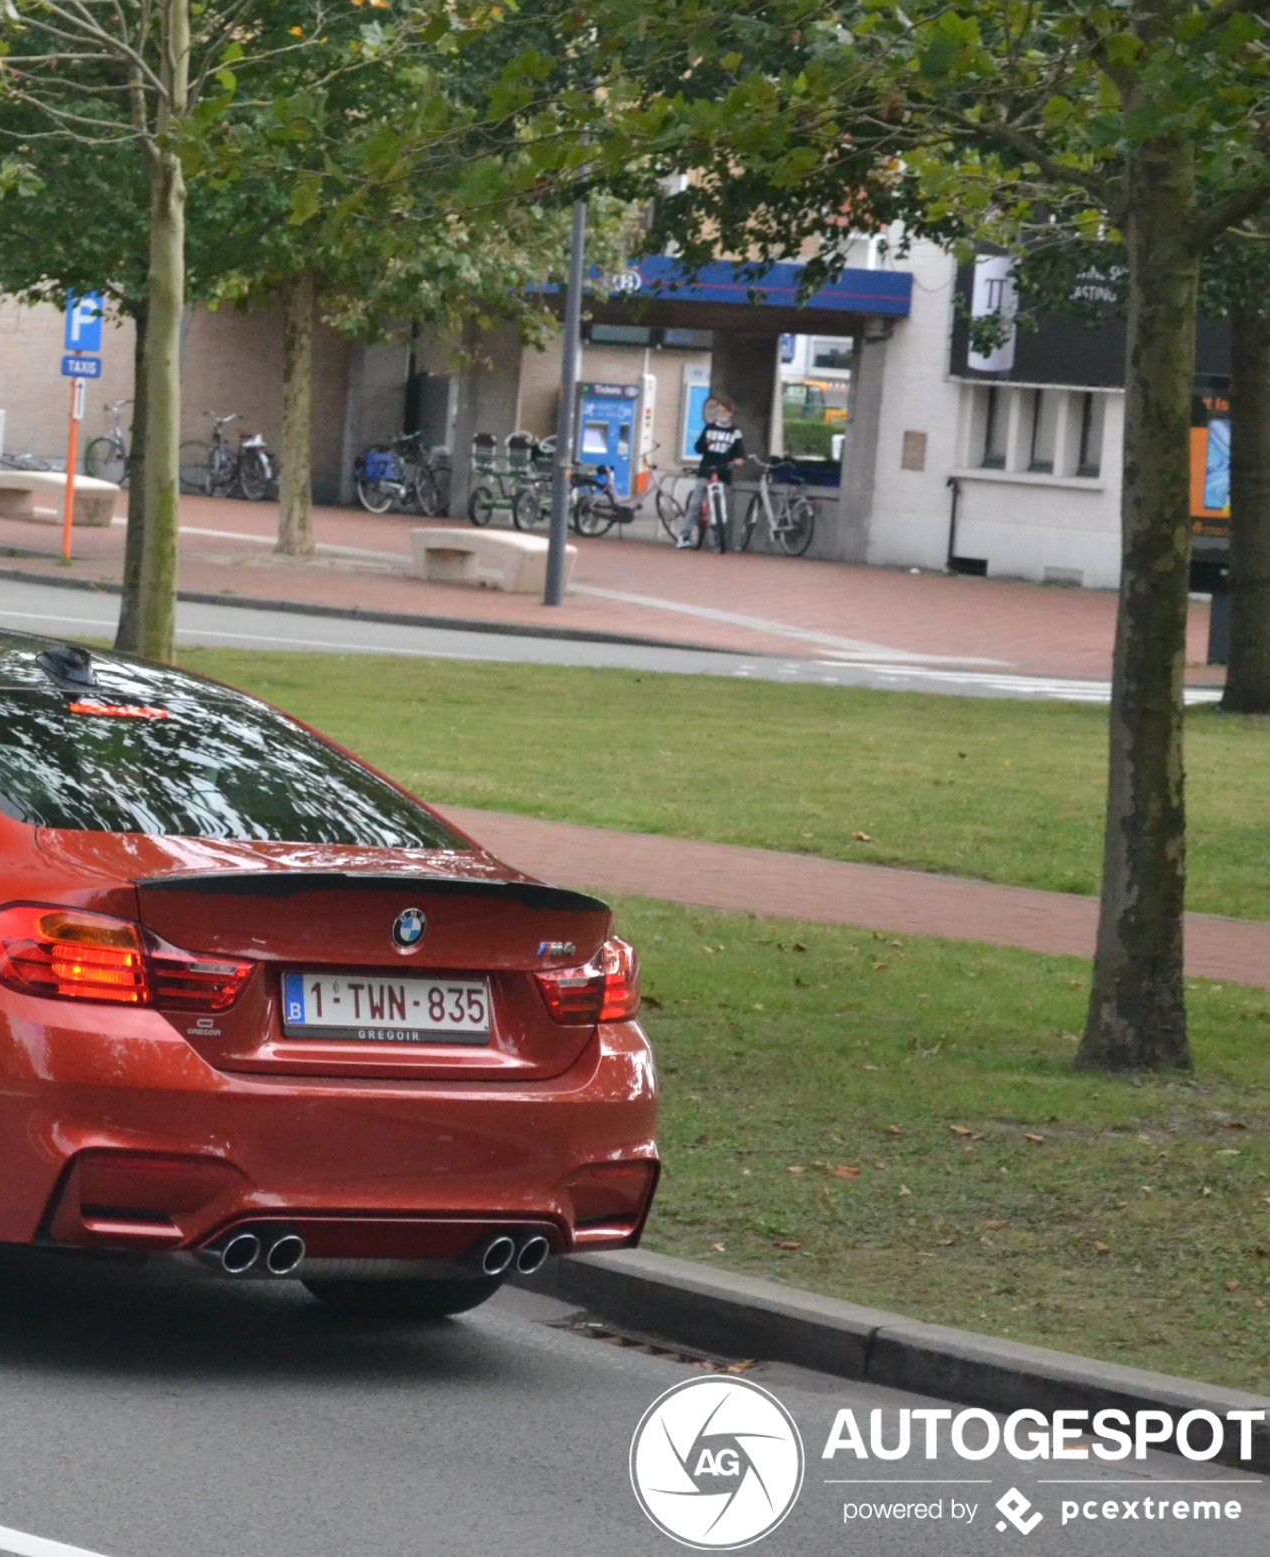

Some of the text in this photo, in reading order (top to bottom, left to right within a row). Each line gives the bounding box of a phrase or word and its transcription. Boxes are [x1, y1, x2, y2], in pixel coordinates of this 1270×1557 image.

[71, 299, 99, 341] P
[68, 359, 97, 375] TAXIS
[594, 384, 622, 395] Tickets
[290, 1002, 302, 1019] B
[311, 981, 485, 1024] 1-TWN-835
[187, 1028, 222, 1037] GREGOIR
[358, 1029, 420, 1041] GREGOIR
